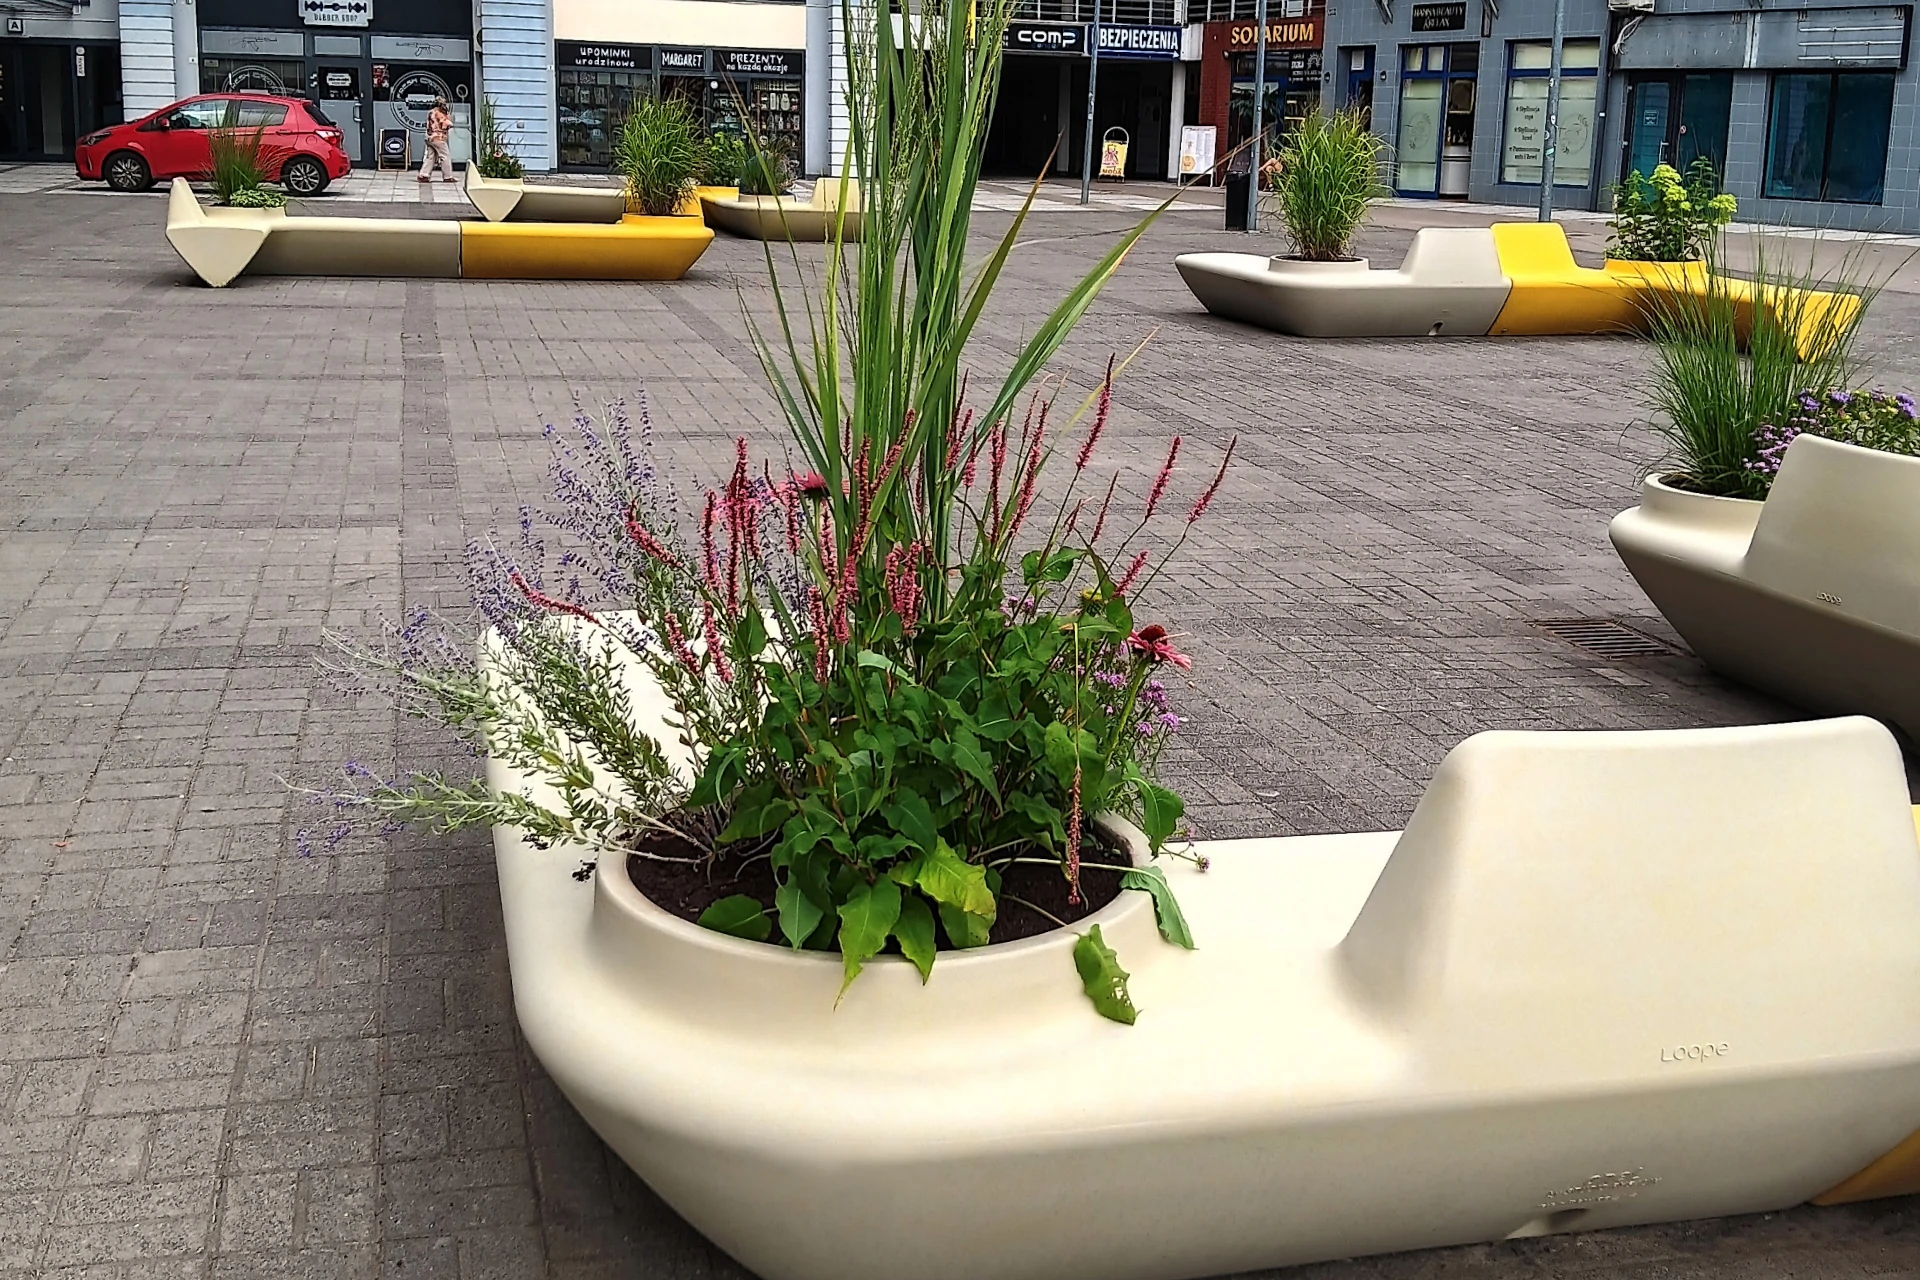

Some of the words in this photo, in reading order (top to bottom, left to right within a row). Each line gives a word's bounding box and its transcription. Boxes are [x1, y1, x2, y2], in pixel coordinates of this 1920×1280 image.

[11, 21, 19, 29] A
[1231, 23, 1314, 44] SOLARIUM
[580, 47, 630, 58] UPOMINKI
[575, 57, 635, 67] urodzinowe
[662, 52, 703, 67] MARGARET
[730, 53, 784, 64] PREZENTY
